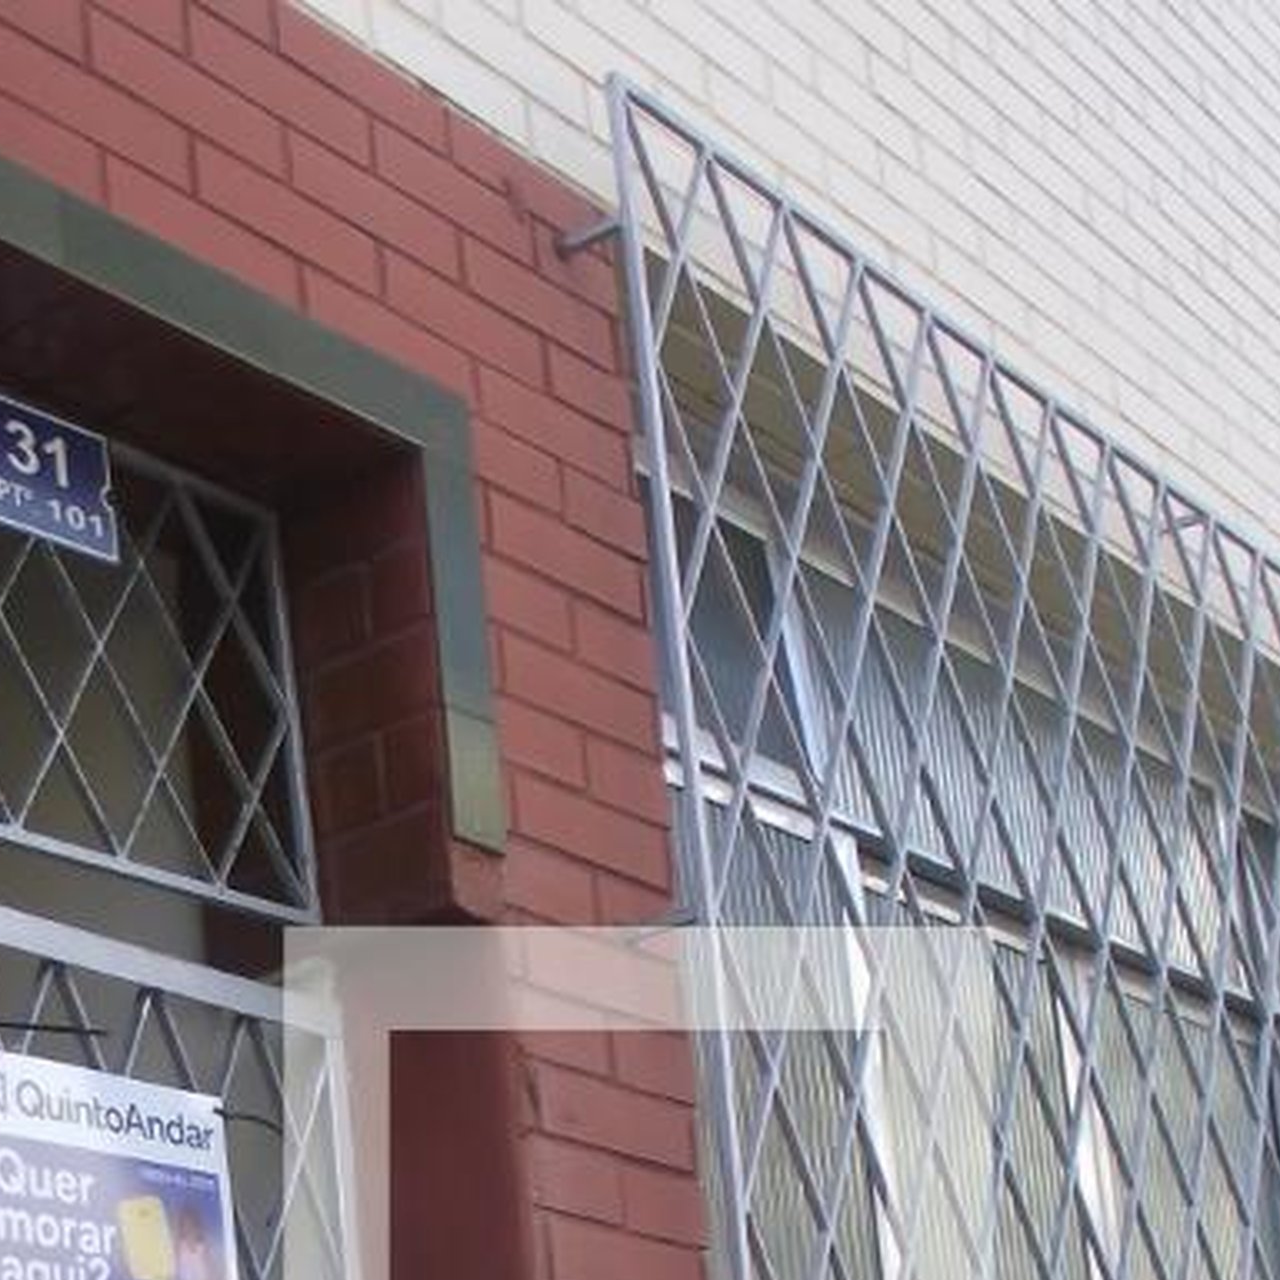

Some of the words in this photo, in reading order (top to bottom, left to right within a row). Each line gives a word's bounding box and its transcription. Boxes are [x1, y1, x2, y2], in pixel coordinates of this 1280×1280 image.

[4, 418, 69, 489] 31
[47, 499, 104, 538] 101
[16, 1078, 215, 1151] QuintoAndar
